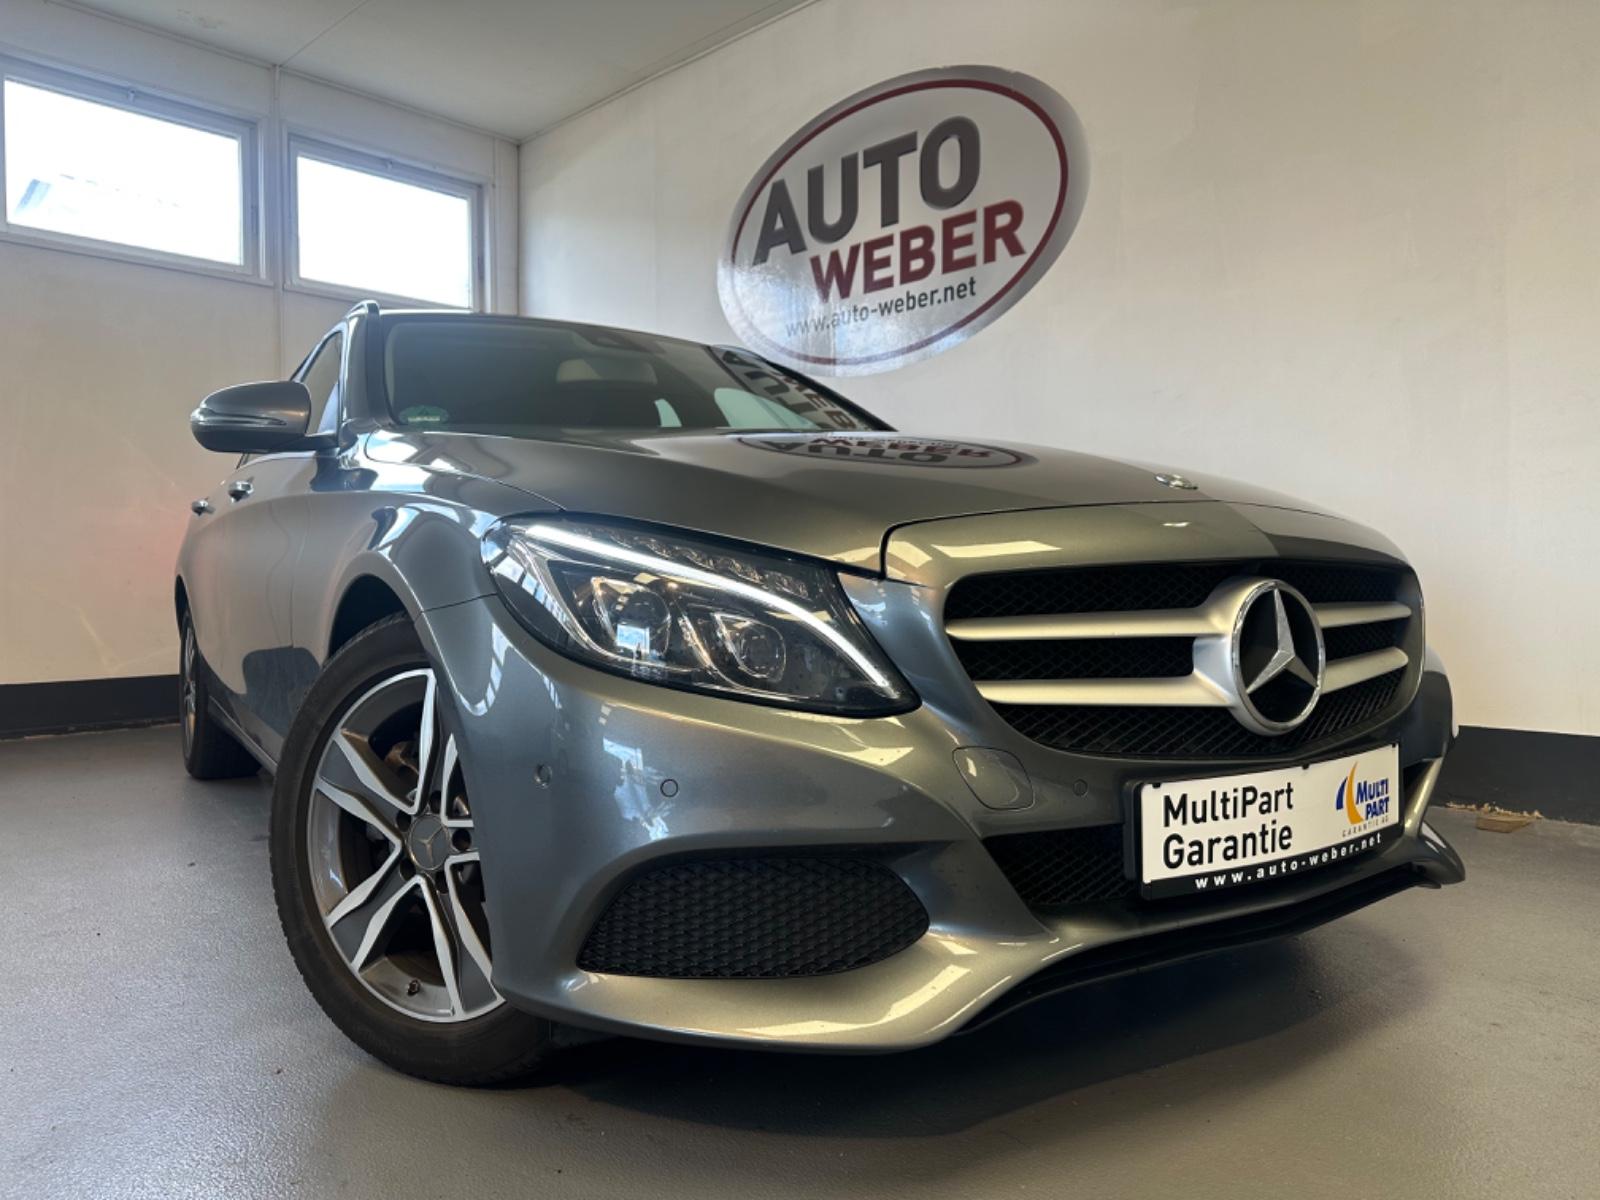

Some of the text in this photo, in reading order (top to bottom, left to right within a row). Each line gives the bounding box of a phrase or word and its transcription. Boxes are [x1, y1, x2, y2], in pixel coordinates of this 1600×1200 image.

[752, 115, 981, 267] AUTO
[809, 199, 1027, 304] WEBER
[785, 276, 977, 338] www.auto-weber.net
[1163, 781, 1294, 828] MultiPart
[1365, 796, 1390, 821] PART
[1163, 819, 1293, 870] Garantie
[1195, 832, 1382, 890] www.auto-weber.net
